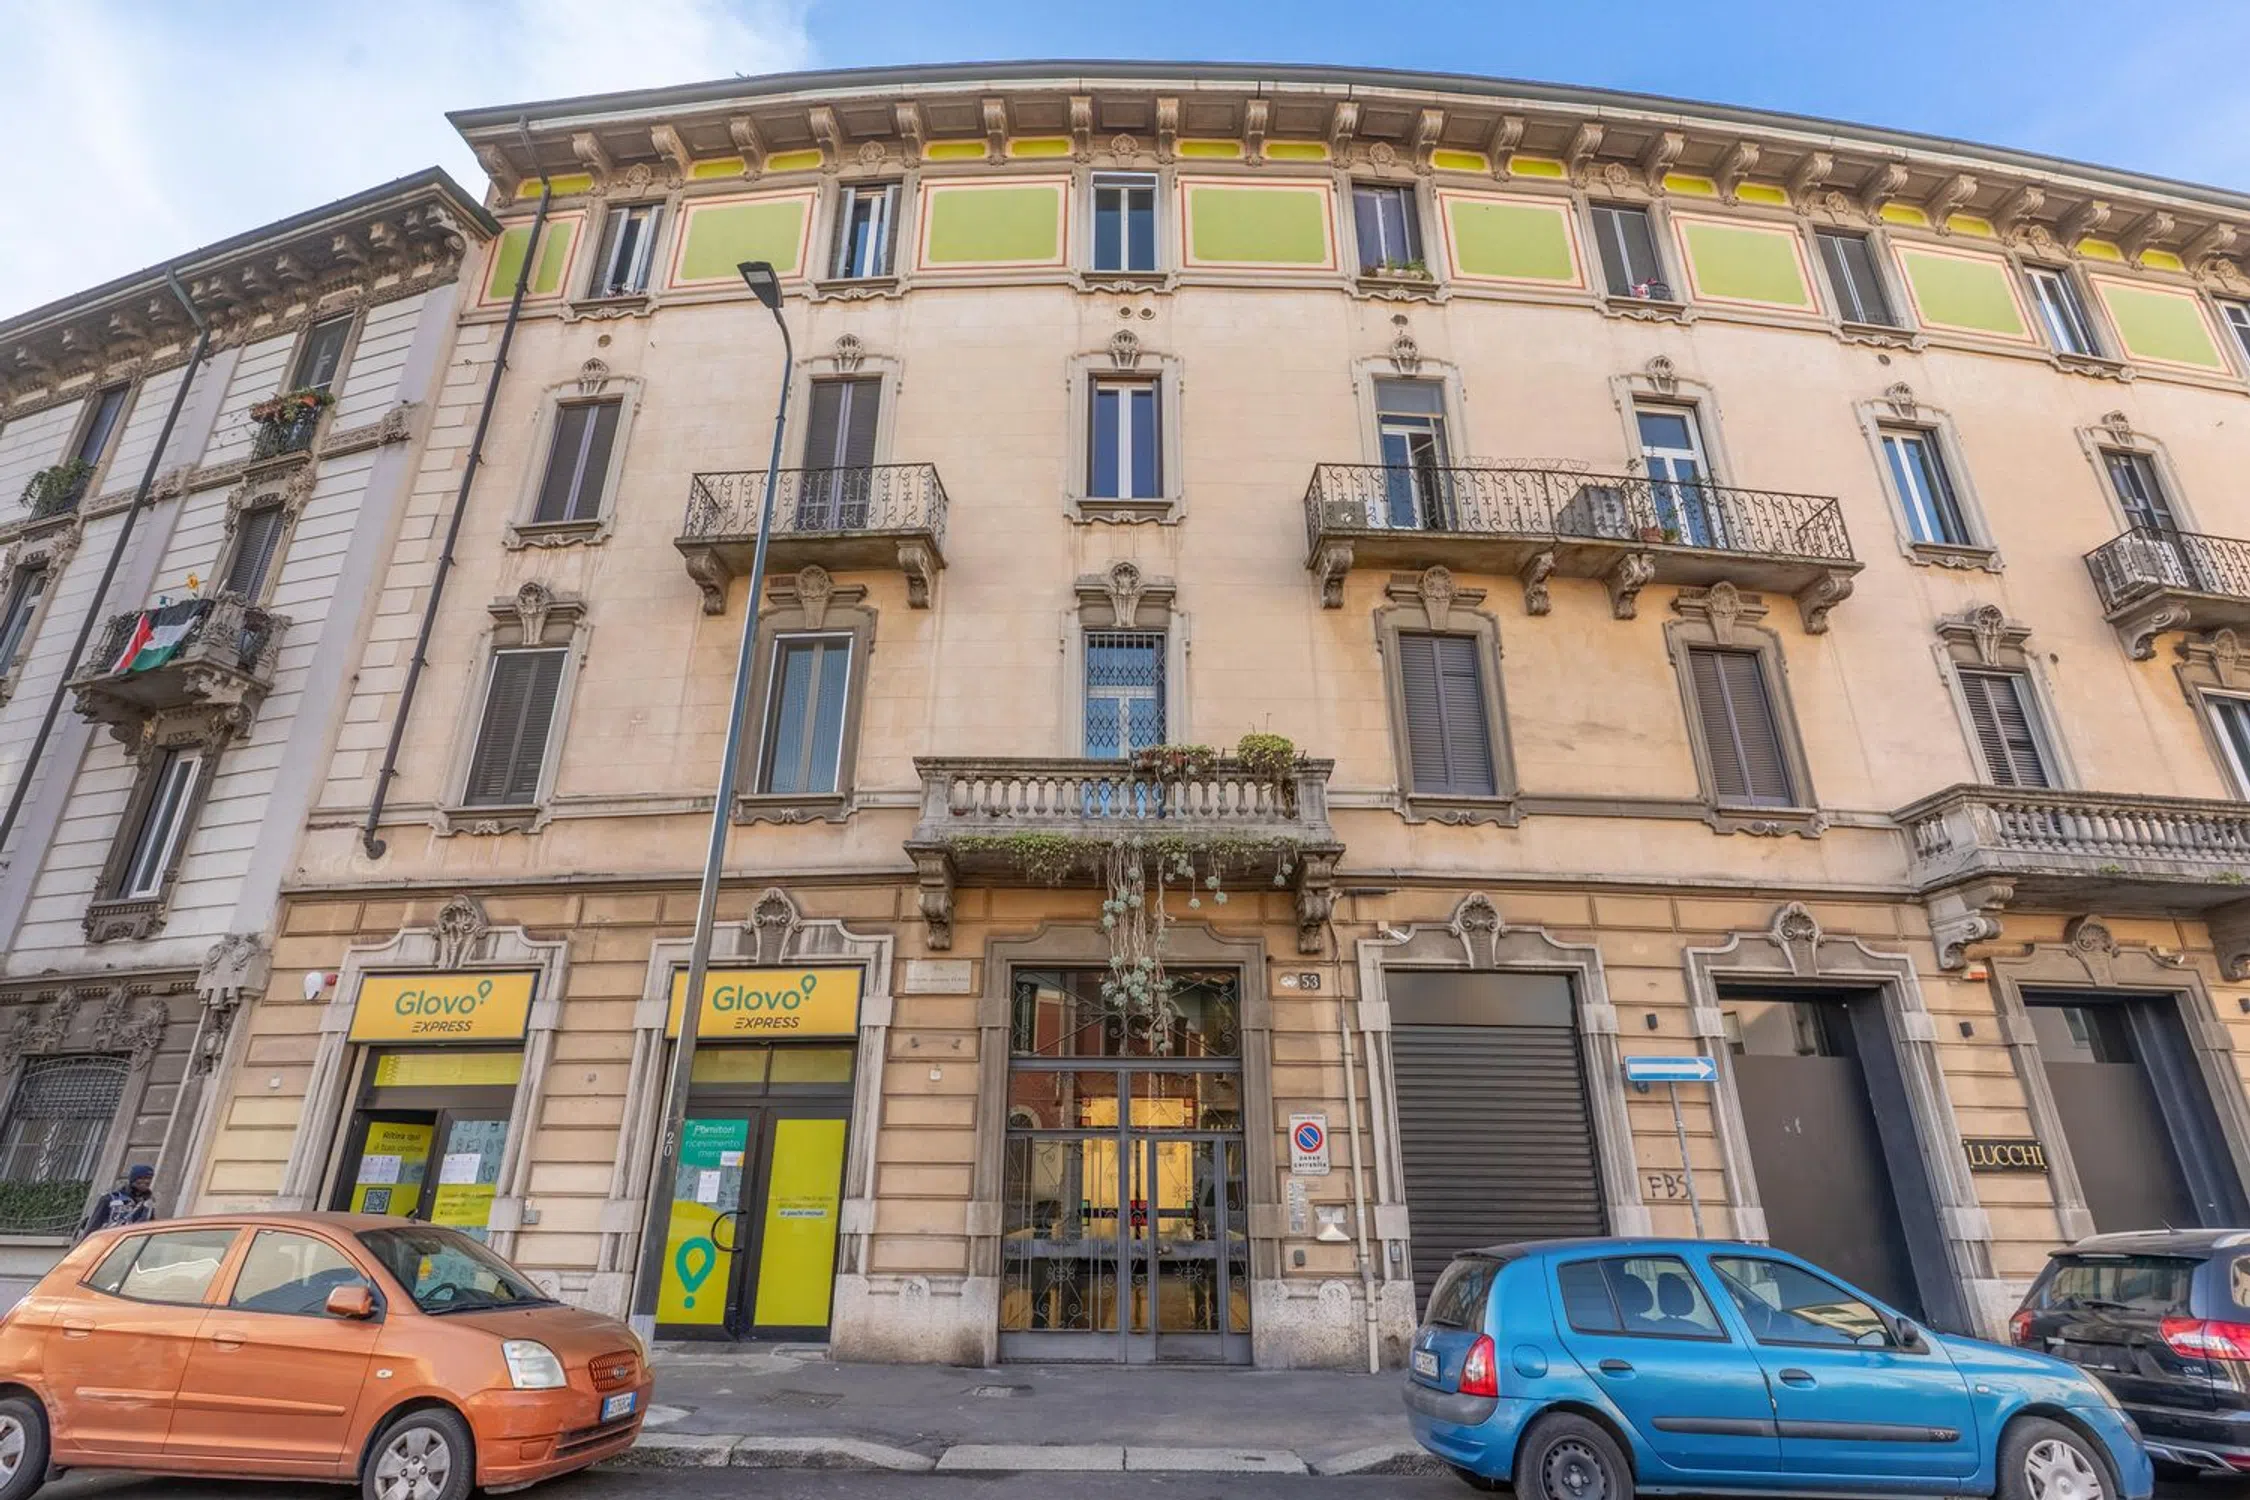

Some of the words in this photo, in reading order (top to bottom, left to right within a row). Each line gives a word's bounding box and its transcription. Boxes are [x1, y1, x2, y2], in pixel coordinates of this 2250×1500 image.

[1302, 975, 1318, 988] 53
[395, 990, 476, 1015] Glovo
[713, 985, 800, 1012] Glovo
[412, 1020, 473, 1032] EXPRESS
[734, 1017, 800, 1029] EXPRESS
[1967, 1145, 2045, 1165] LUCCHI
[1647, 1173, 1689, 1199] FBS
